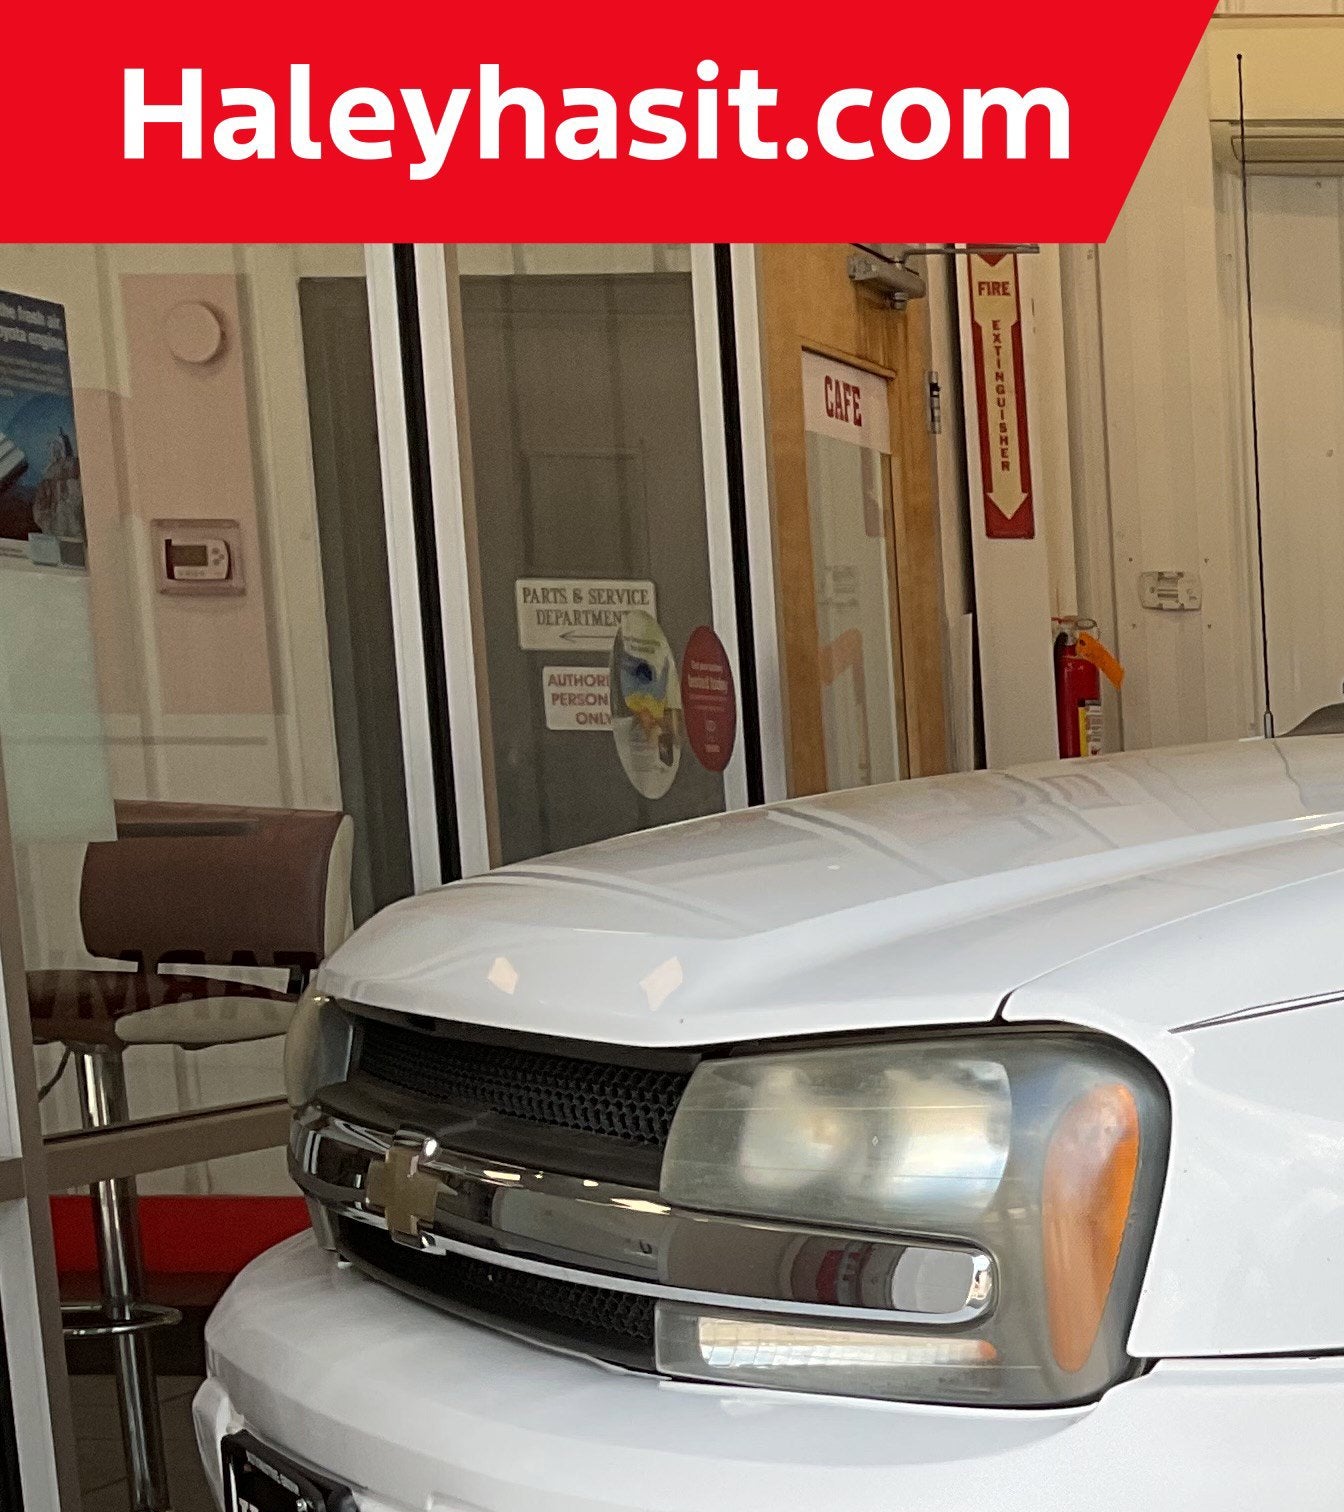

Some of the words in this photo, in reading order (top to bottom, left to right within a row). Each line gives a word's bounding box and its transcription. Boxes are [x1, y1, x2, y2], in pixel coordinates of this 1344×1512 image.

[977, 281, 1012, 297] FIRE
[824, 374, 862, 427] CAFE
[991, 319, 1010, 472] EXTINGUISHER
[522, 587, 567, 604] PARTS
[588, 588, 649, 605] SERVICE
